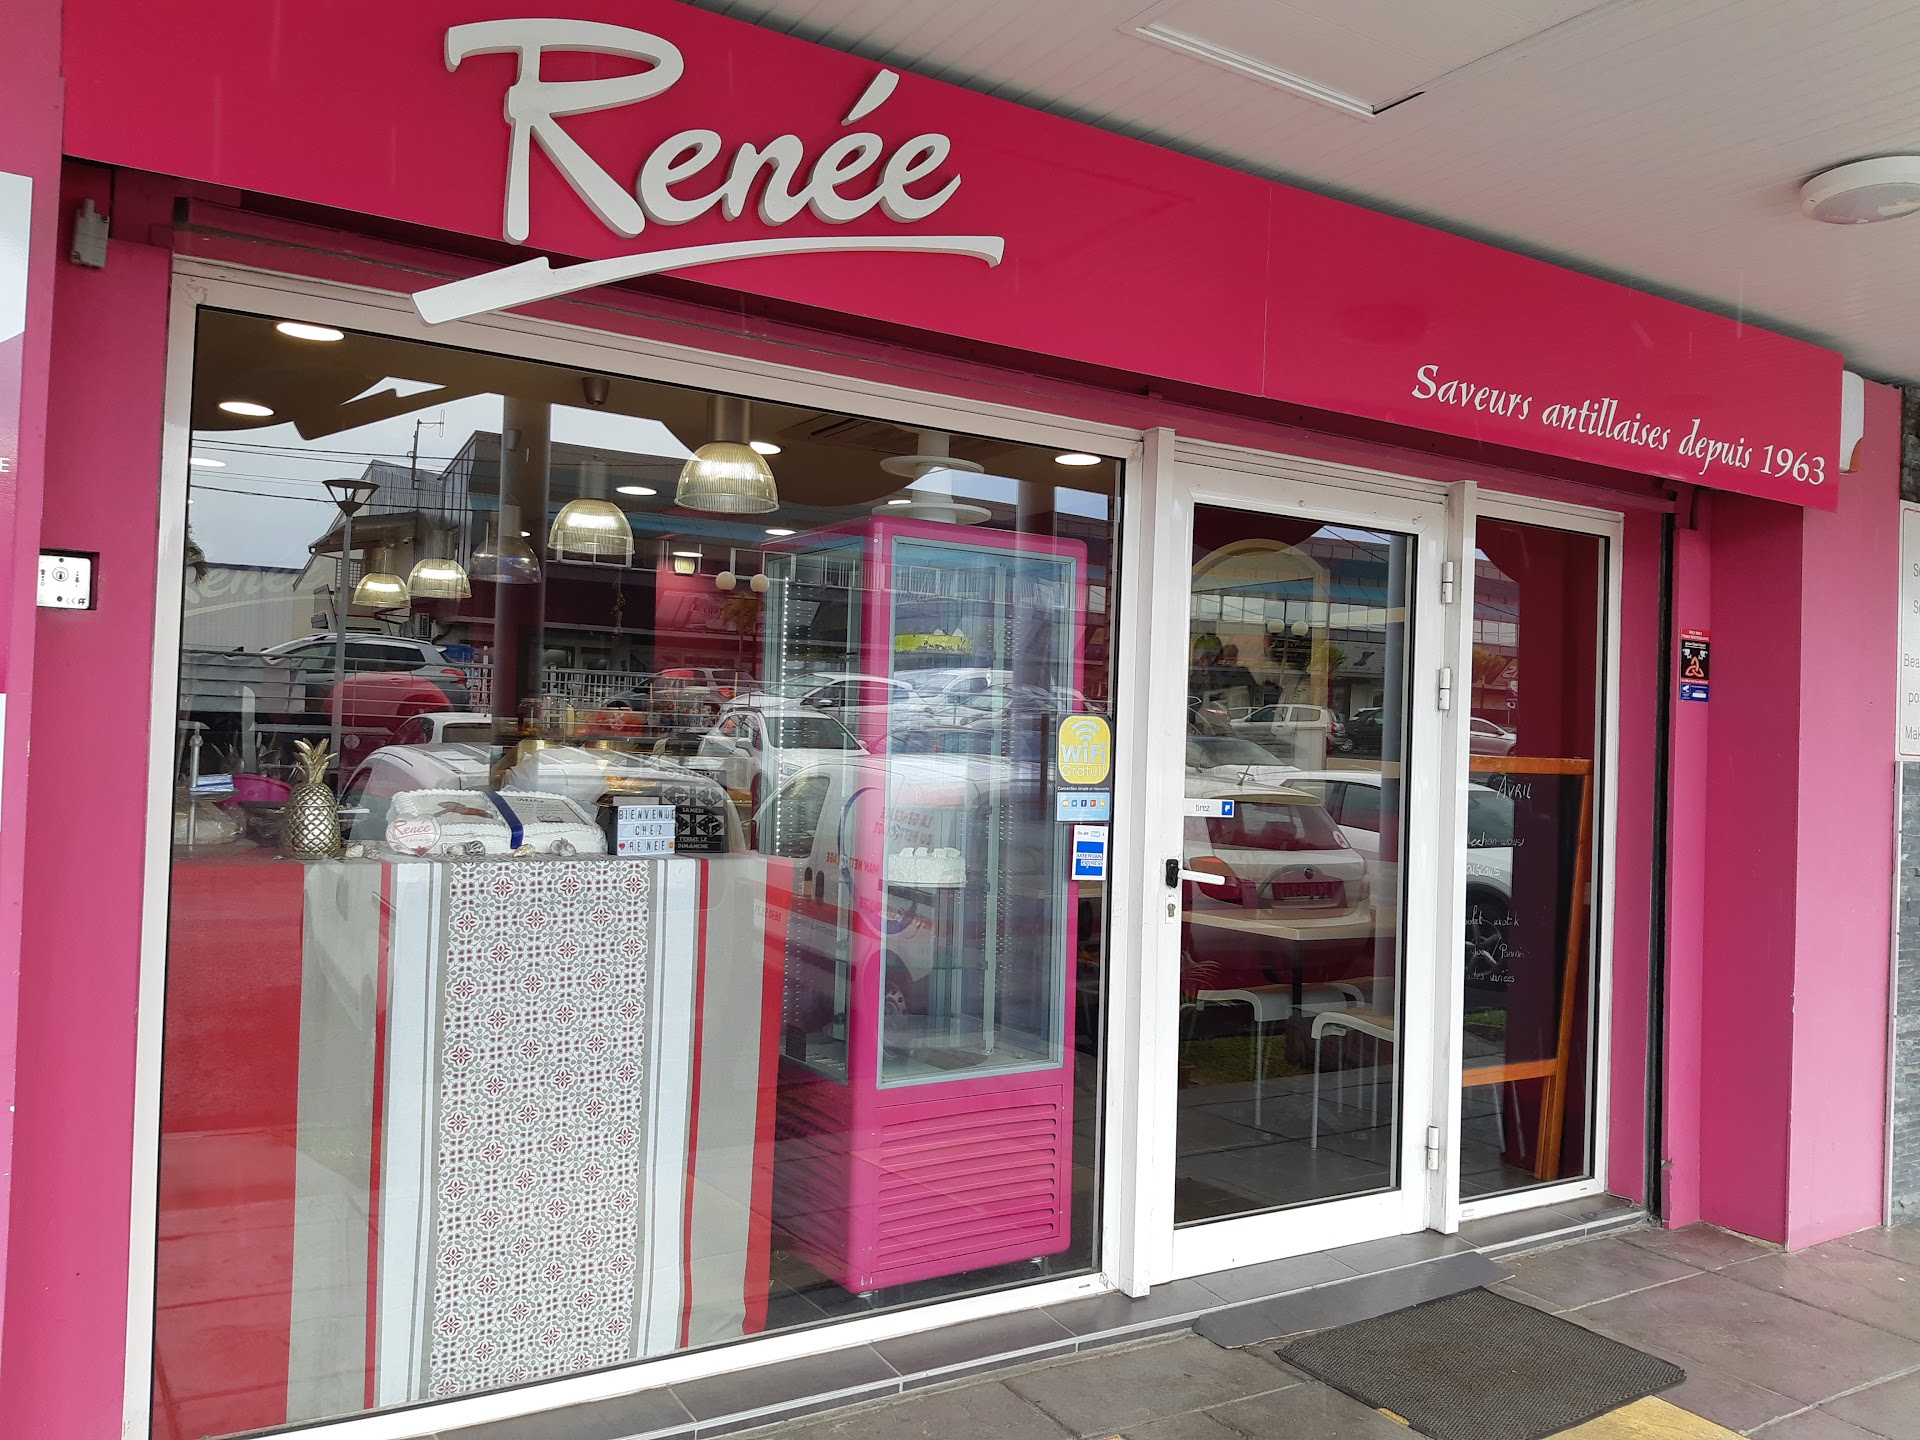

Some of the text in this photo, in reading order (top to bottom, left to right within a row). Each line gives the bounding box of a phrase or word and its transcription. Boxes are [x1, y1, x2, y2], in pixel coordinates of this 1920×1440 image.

[444, 18, 961, 245] Renée
[1411, 364, 1826, 486] Saveurs antillaises depuis 1963
[1061, 741, 1107, 764] WiFi
[1061, 765, 1107, 778] Gratuit
[619, 808, 676, 820] BIENVENUE
[1195, 804, 1211, 812] tirez
[392, 819, 431, 835] Renée
[635, 825, 662, 836] CHEZ
